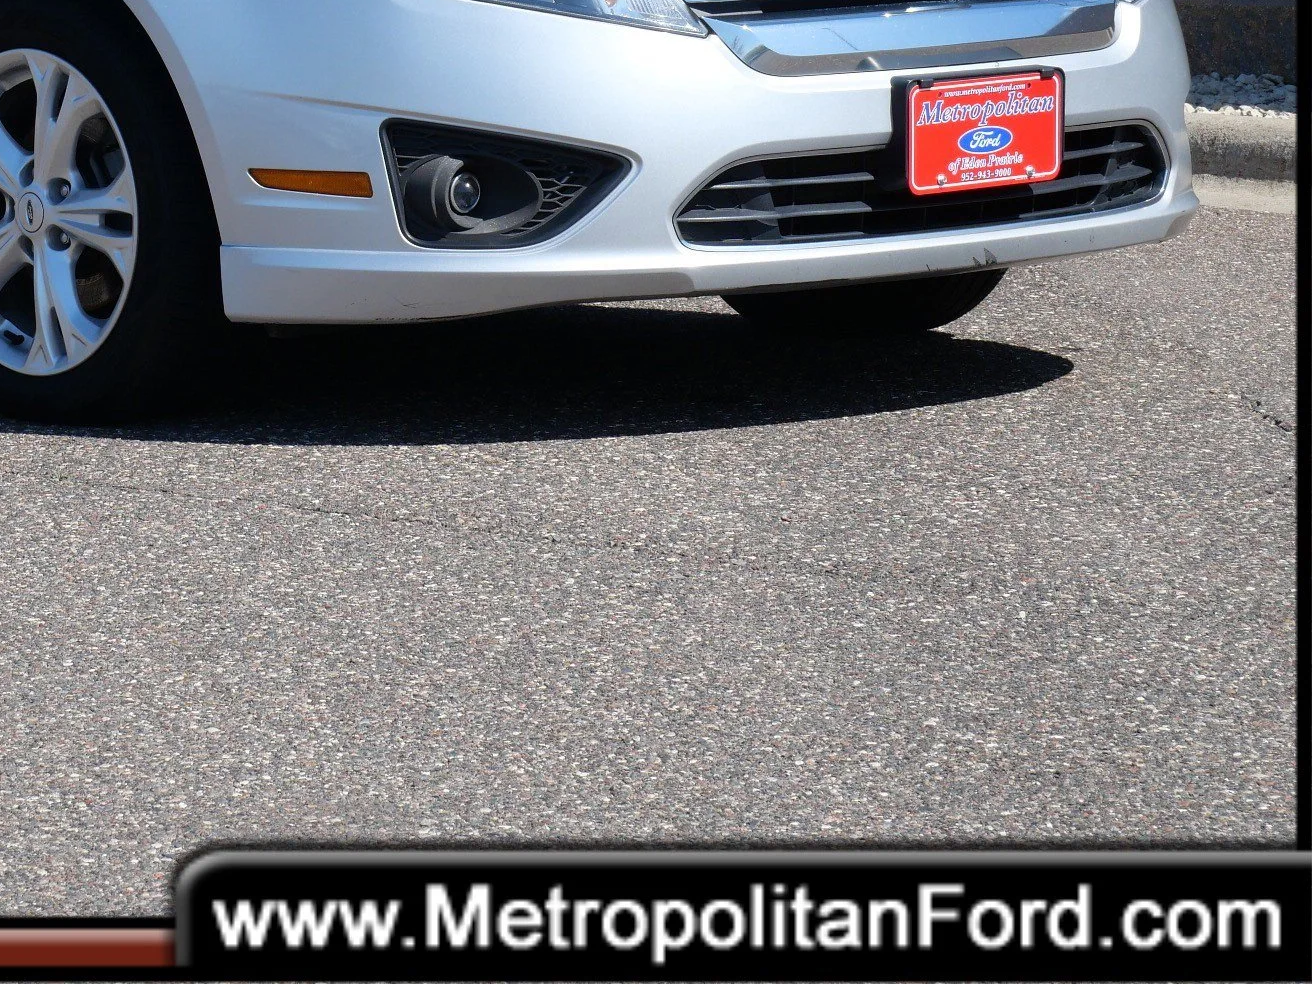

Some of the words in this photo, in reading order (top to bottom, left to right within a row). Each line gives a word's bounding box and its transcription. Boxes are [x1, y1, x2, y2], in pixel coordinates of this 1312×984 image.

[916, 91, 1054, 127] Metropolitan
[969, 130, 1002, 149] Ford
[948, 158, 962, 175] of
[960, 156, 987, 171] Eden
[987, 151, 1024, 167] Prairie
[961, 168, 1012, 182] 952-943-9000
